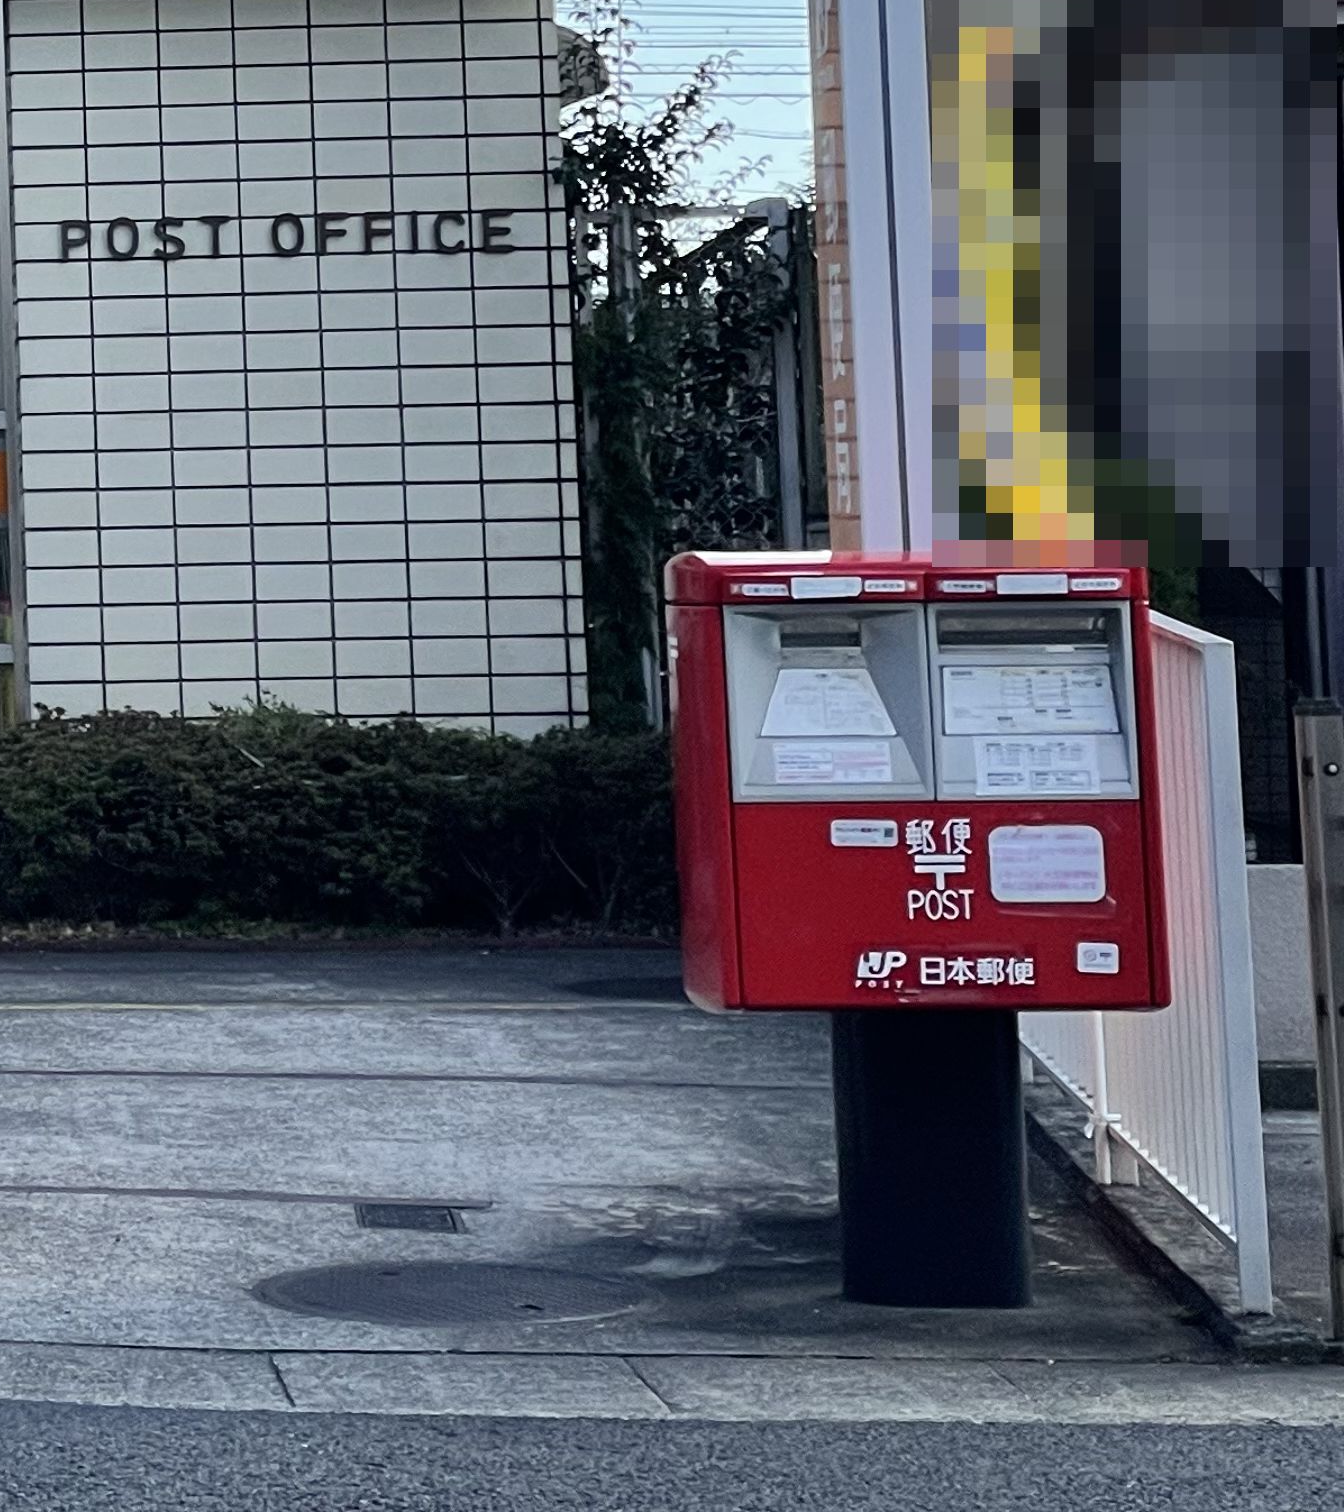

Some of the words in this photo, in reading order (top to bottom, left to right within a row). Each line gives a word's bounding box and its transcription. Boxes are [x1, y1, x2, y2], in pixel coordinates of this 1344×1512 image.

[59, 216, 231, 261] POST
[270, 210, 512, 257] OFFICE
[905, 818, 972, 855] 郵便
[906, 889, 974, 920] POST
[919, 956, 1035, 986] 日本郵便
